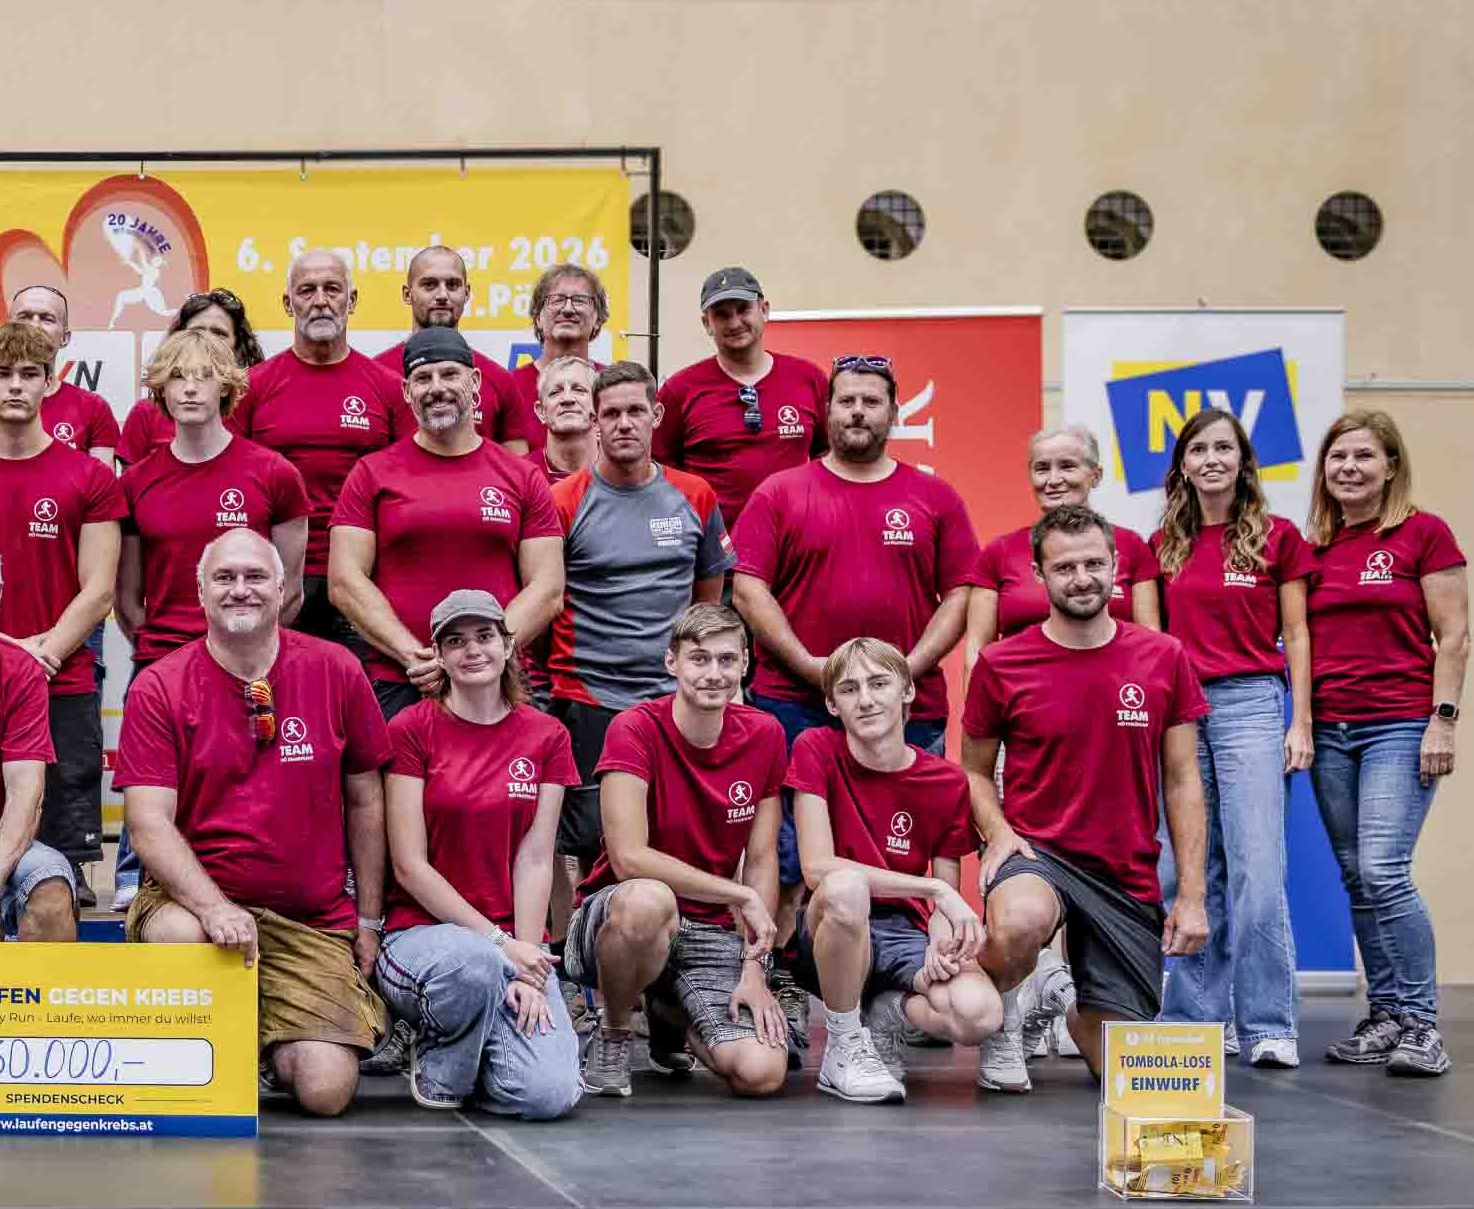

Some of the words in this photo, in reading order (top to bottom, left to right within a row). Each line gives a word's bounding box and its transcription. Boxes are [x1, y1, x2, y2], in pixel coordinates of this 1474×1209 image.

[108, 213, 126, 226] 20
[130, 217, 172, 254] JAHRE
[237, 236, 274, 272] 6.
[509, 236, 609, 271] 2026
[340, 414, 370, 426] TEAM
[1148, 388, 1266, 453] NV
[778, 425, 805, 434] TEAM
[216, 511, 248, 522] TEAM
[480, 506, 511, 518] TEAM
[28, 521, 59, 534] TEAM
[882, 530, 914, 541] TEAM
[1224, 572, 1257, 583] TEAM
[1116, 710, 1149, 721] TEAM
[279, 743, 314, 756] TEAM
[507, 782, 538, 793] TEAM
[727, 805, 755, 819] TEAM
[886, 835, 910, 850] TEAM
[49, 988, 128, 1006] GEGEN
[135, 988, 213, 1006] KREBS
[9, 1012, 35, 1023] Run
[46, 1012, 84, 1025] Laufe,
[86, 1013, 106, 1023] wo
[109, 1012, 152, 1024] immer
[155, 1012, 172, 1024] du
[174, 1012, 212, 1024] willst!
[1120, 1055, 1211, 1069] TOMBOLA-LOSE
[1131, 1077, 1200, 1092] EINWURF
[5, 1093, 125, 1105] SPENDENSCHECK
